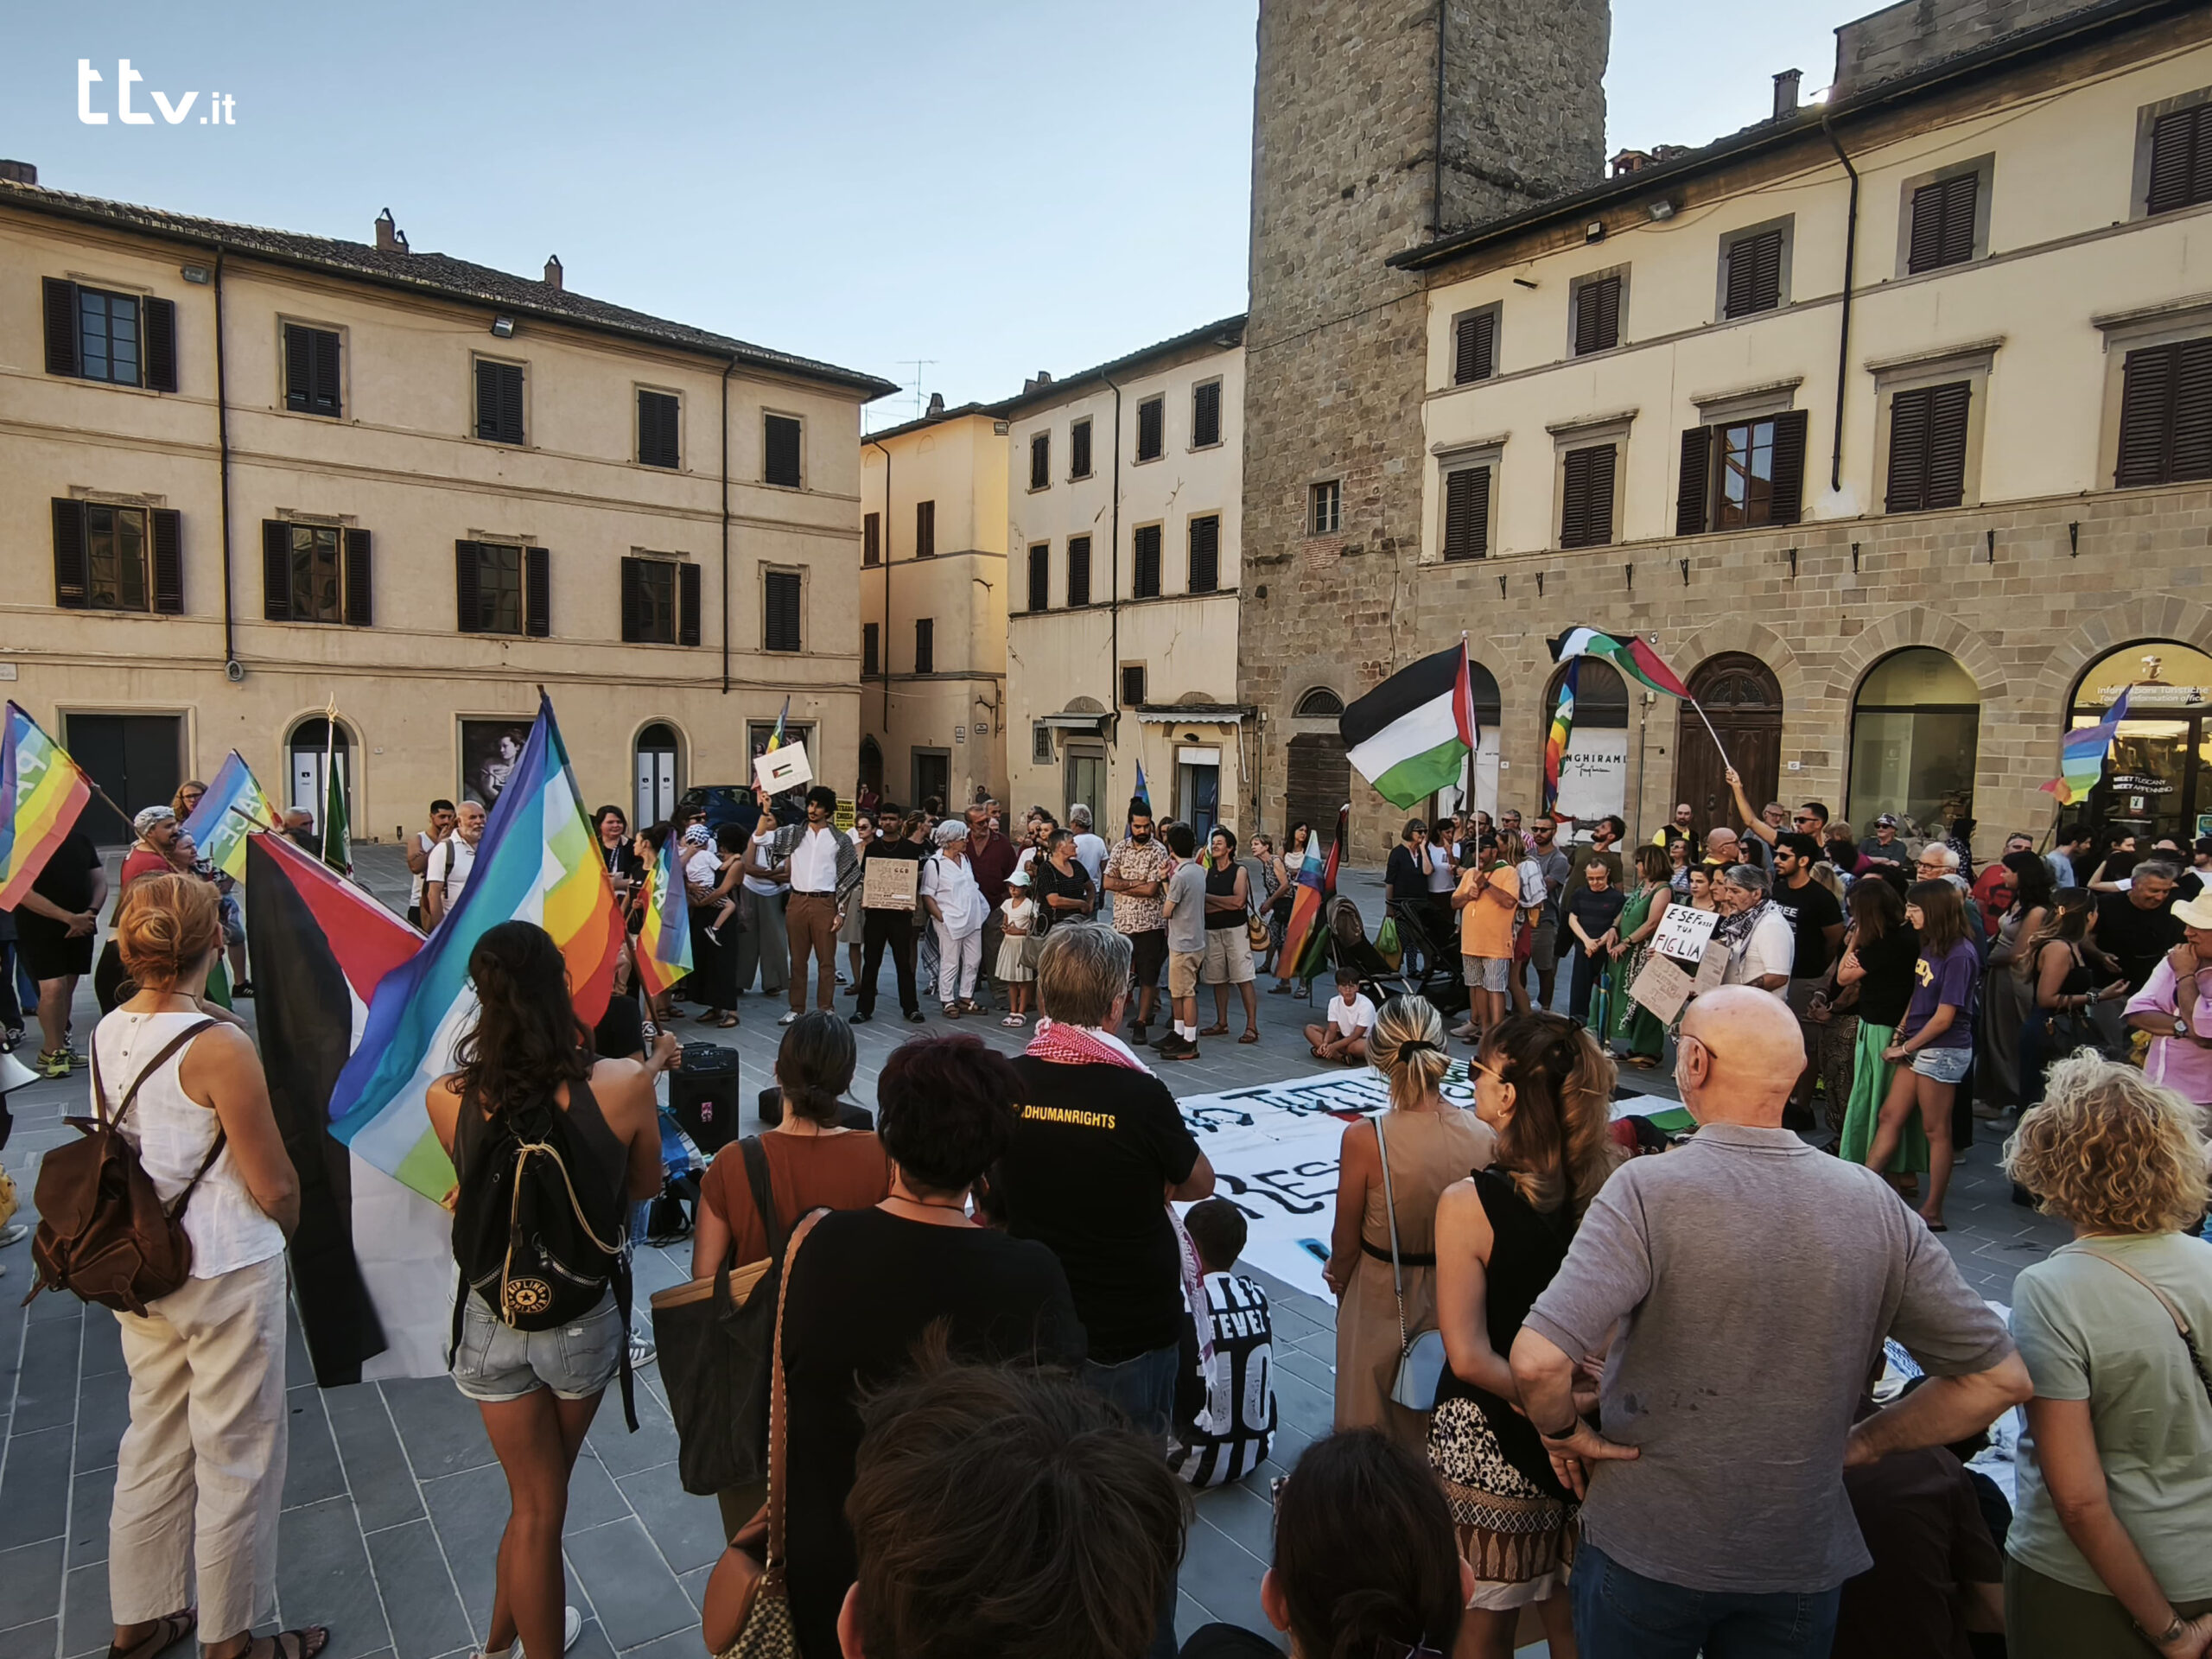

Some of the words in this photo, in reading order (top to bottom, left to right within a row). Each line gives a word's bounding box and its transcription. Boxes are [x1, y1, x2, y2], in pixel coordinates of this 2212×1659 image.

[2180, 694, 2206, 702] office
[1566, 753, 1628, 763] NGHIRAMI
[1676, 925, 1692, 933] TUA
[1654, 934, 1700, 960] FIGLIA
[1013, 1103, 1116, 1129] DHUMANRIGHTS
